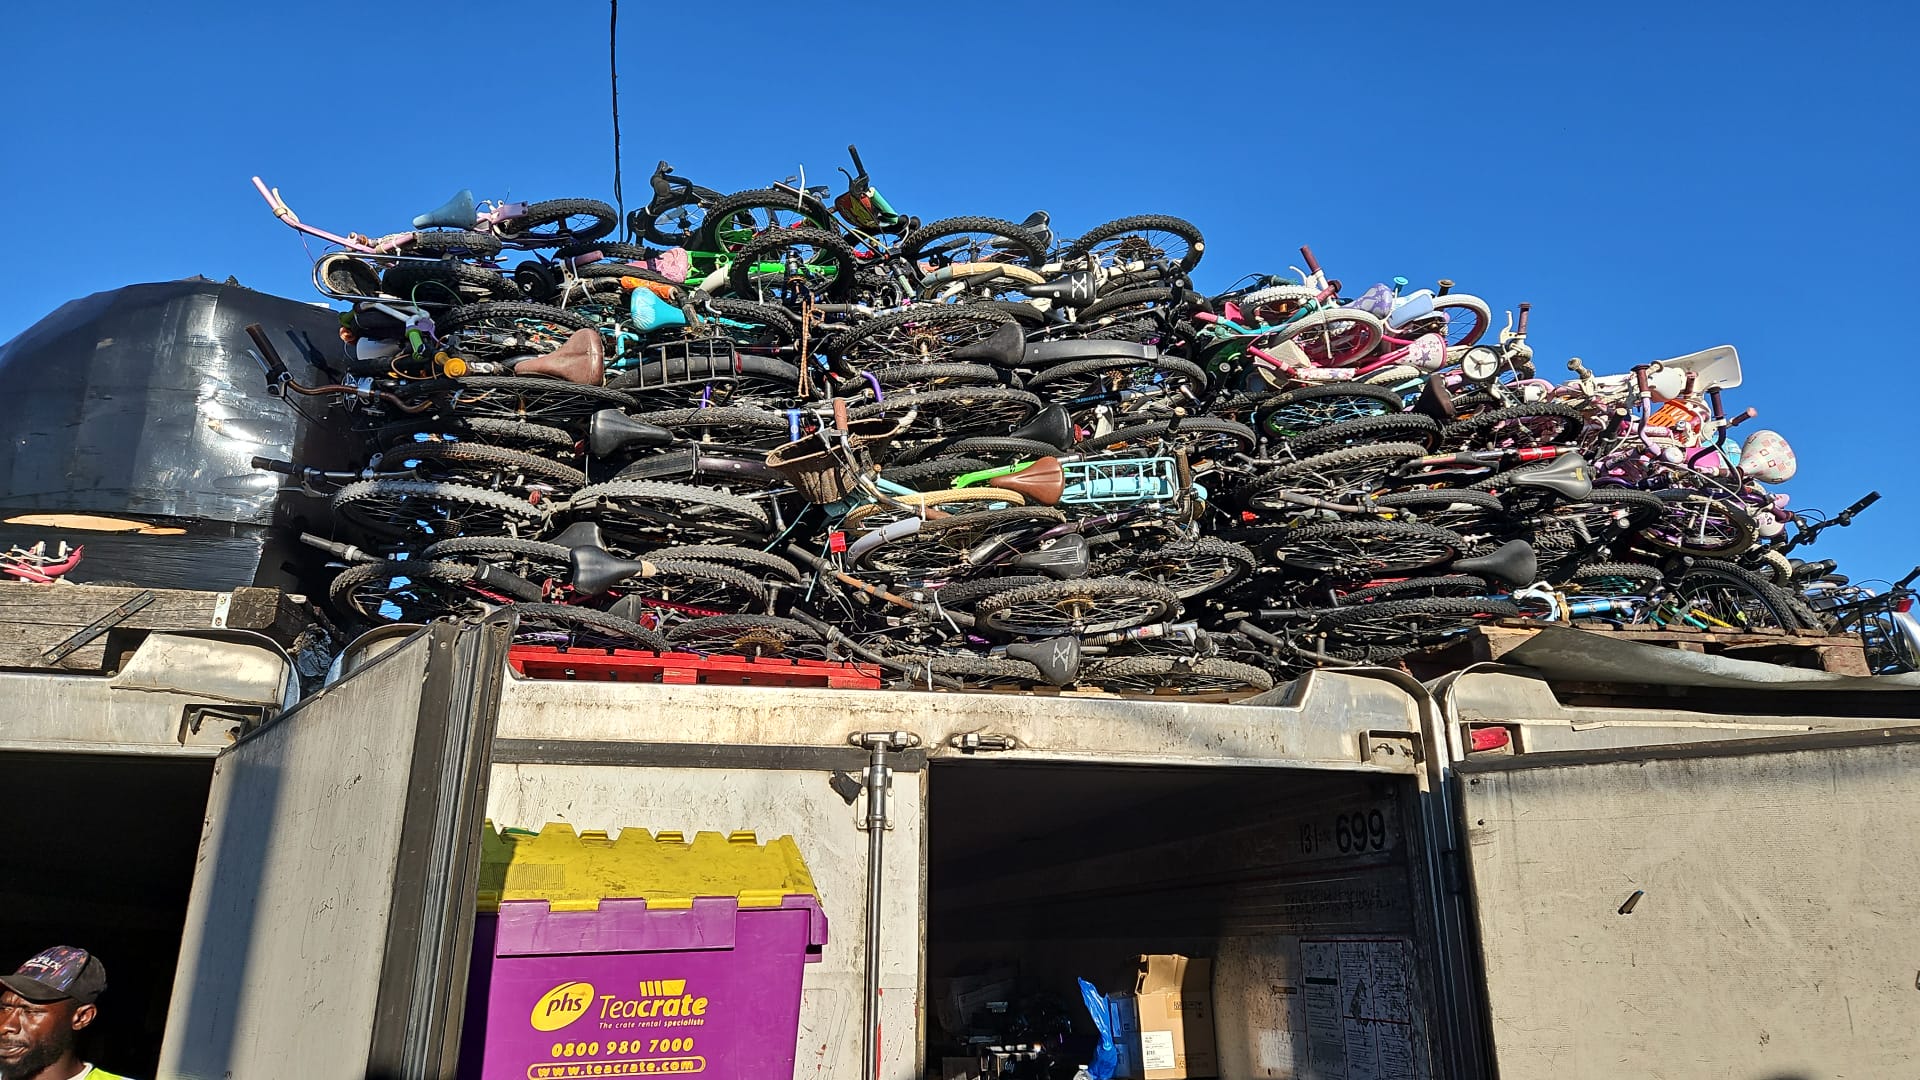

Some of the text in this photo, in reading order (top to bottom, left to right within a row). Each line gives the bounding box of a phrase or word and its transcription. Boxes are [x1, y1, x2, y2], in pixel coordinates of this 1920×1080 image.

[1335, 808, 1386, 854] 699
[545, 992, 708, 1019] phs Teacrate
[599, 1018, 704, 1030] The crate rental specialists
[551, 1037, 694, 1058] 0800 980 7000
[536, 1060, 695, 1078] www.teacrate.com
